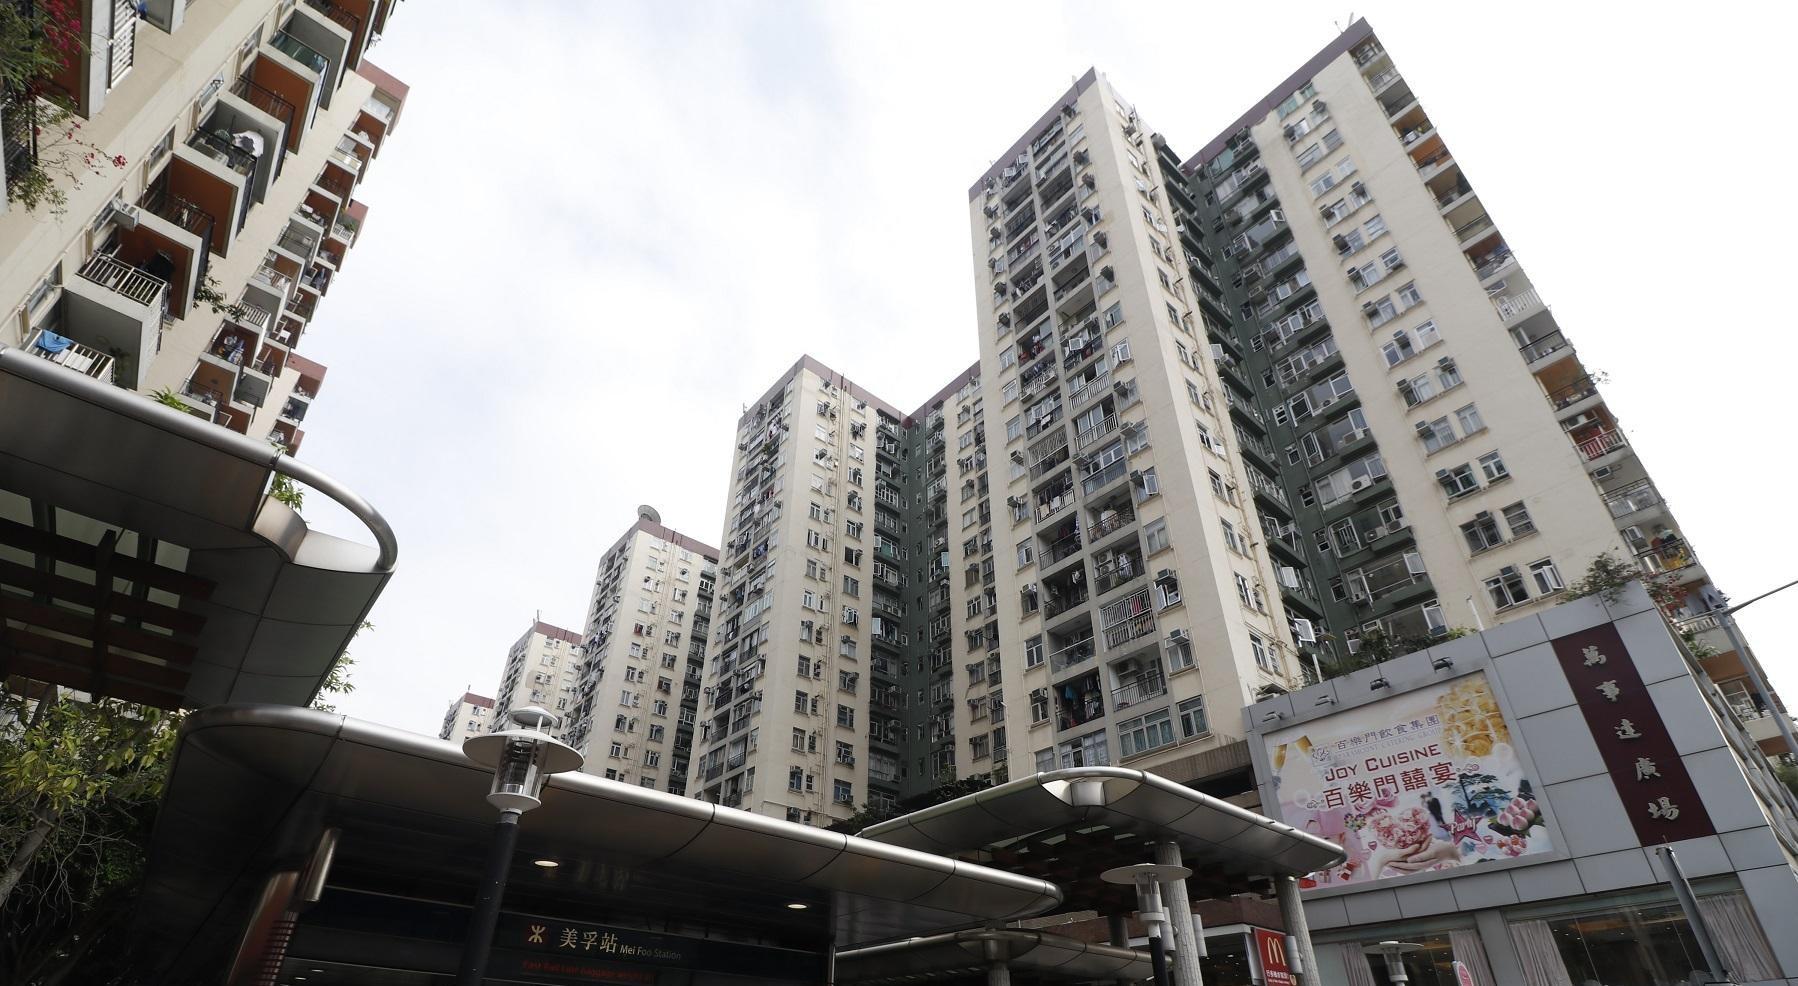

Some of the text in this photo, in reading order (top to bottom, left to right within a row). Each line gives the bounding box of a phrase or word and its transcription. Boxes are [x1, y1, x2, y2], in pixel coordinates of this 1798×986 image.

[1335, 715, 1440, 750] 百樂門飲食集團
[1582, 645, 1680, 820] 萬事達廣場
[1325, 764, 1357, 782] JOY
[1365, 744, 1442, 772] CUISINE
[1323, 762, 1457, 809] 百樂門囍宴
[559, 928, 618, 953] 美孚站
[619, 944, 681, 961] Mei Foo Station
